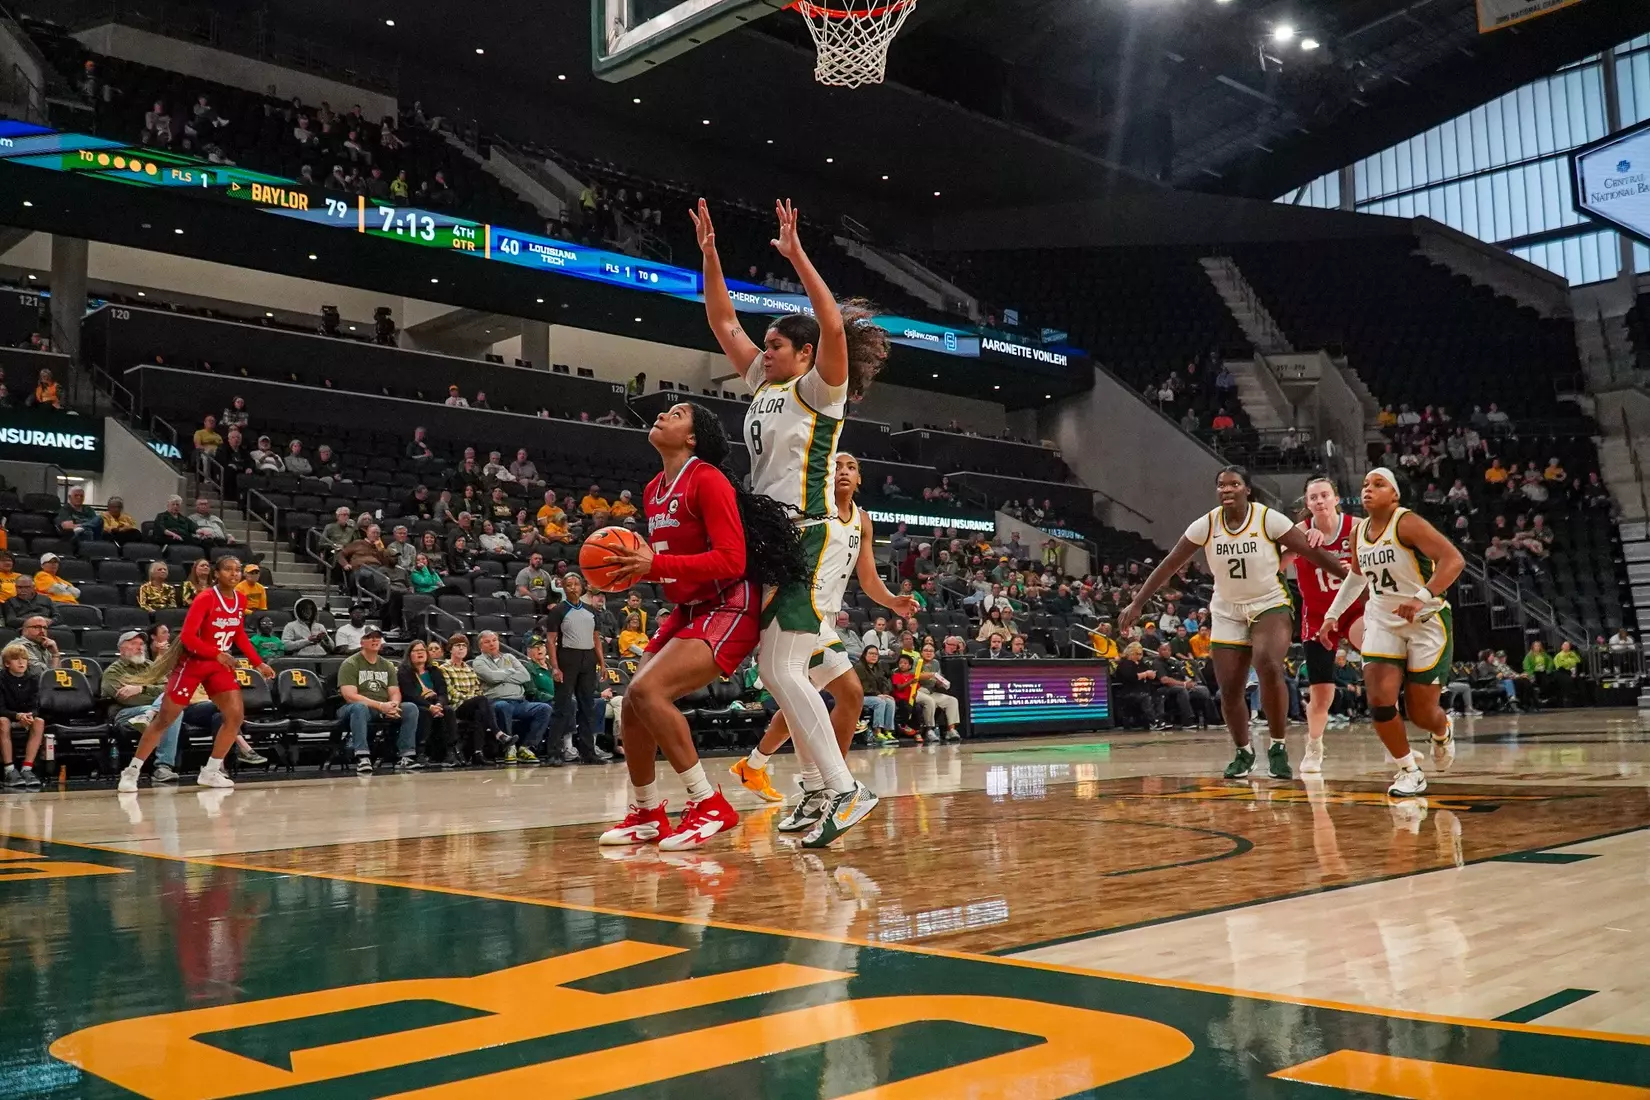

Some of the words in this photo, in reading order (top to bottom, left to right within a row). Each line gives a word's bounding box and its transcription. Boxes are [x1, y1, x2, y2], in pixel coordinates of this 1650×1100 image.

[79, 149, 94, 162] TO
[171, 169, 192, 182] FLS
[200, 173, 208, 188] 1
[251, 183, 309, 211] BAYLOR
[325, 198, 347, 218] 79
[379, 206, 435, 241] 7:13
[452, 224, 475, 239] 4TH
[452, 238, 475, 252] QTR
[500, 237, 519, 256] 40
[528, 243, 577, 261] LOUISIANA
[541, 254, 564, 267] TECH
[605, 263, 619, 274] FLS
[625, 266, 630, 278] 1
[638, 270, 649, 280] TO
[19, 295, 38, 307] 121
[727, 290, 760, 305] CHERRY
[762, 297, 800, 313] JOHNSON
[111, 308, 130, 320] 120
[982, 337, 1032, 359] AARONETTE
[1032, 348, 1068, 367] VONLEH!
[612, 385, 624, 394] 120
[667, 393, 679, 402] 119
[750, 420, 763, 456] 8
[868, 511, 895, 523] TEXAS
[895, 514, 918, 525] FARM
[919, 516, 950, 528] BUREAU
[951, 519, 995, 532] INSURANCE
[1216, 541, 1257, 555] BAYLOR
[1358, 549, 1396, 568] BAYLOR
[1227, 558, 1247, 579] 21
[1365, 568, 1399, 595] 24
